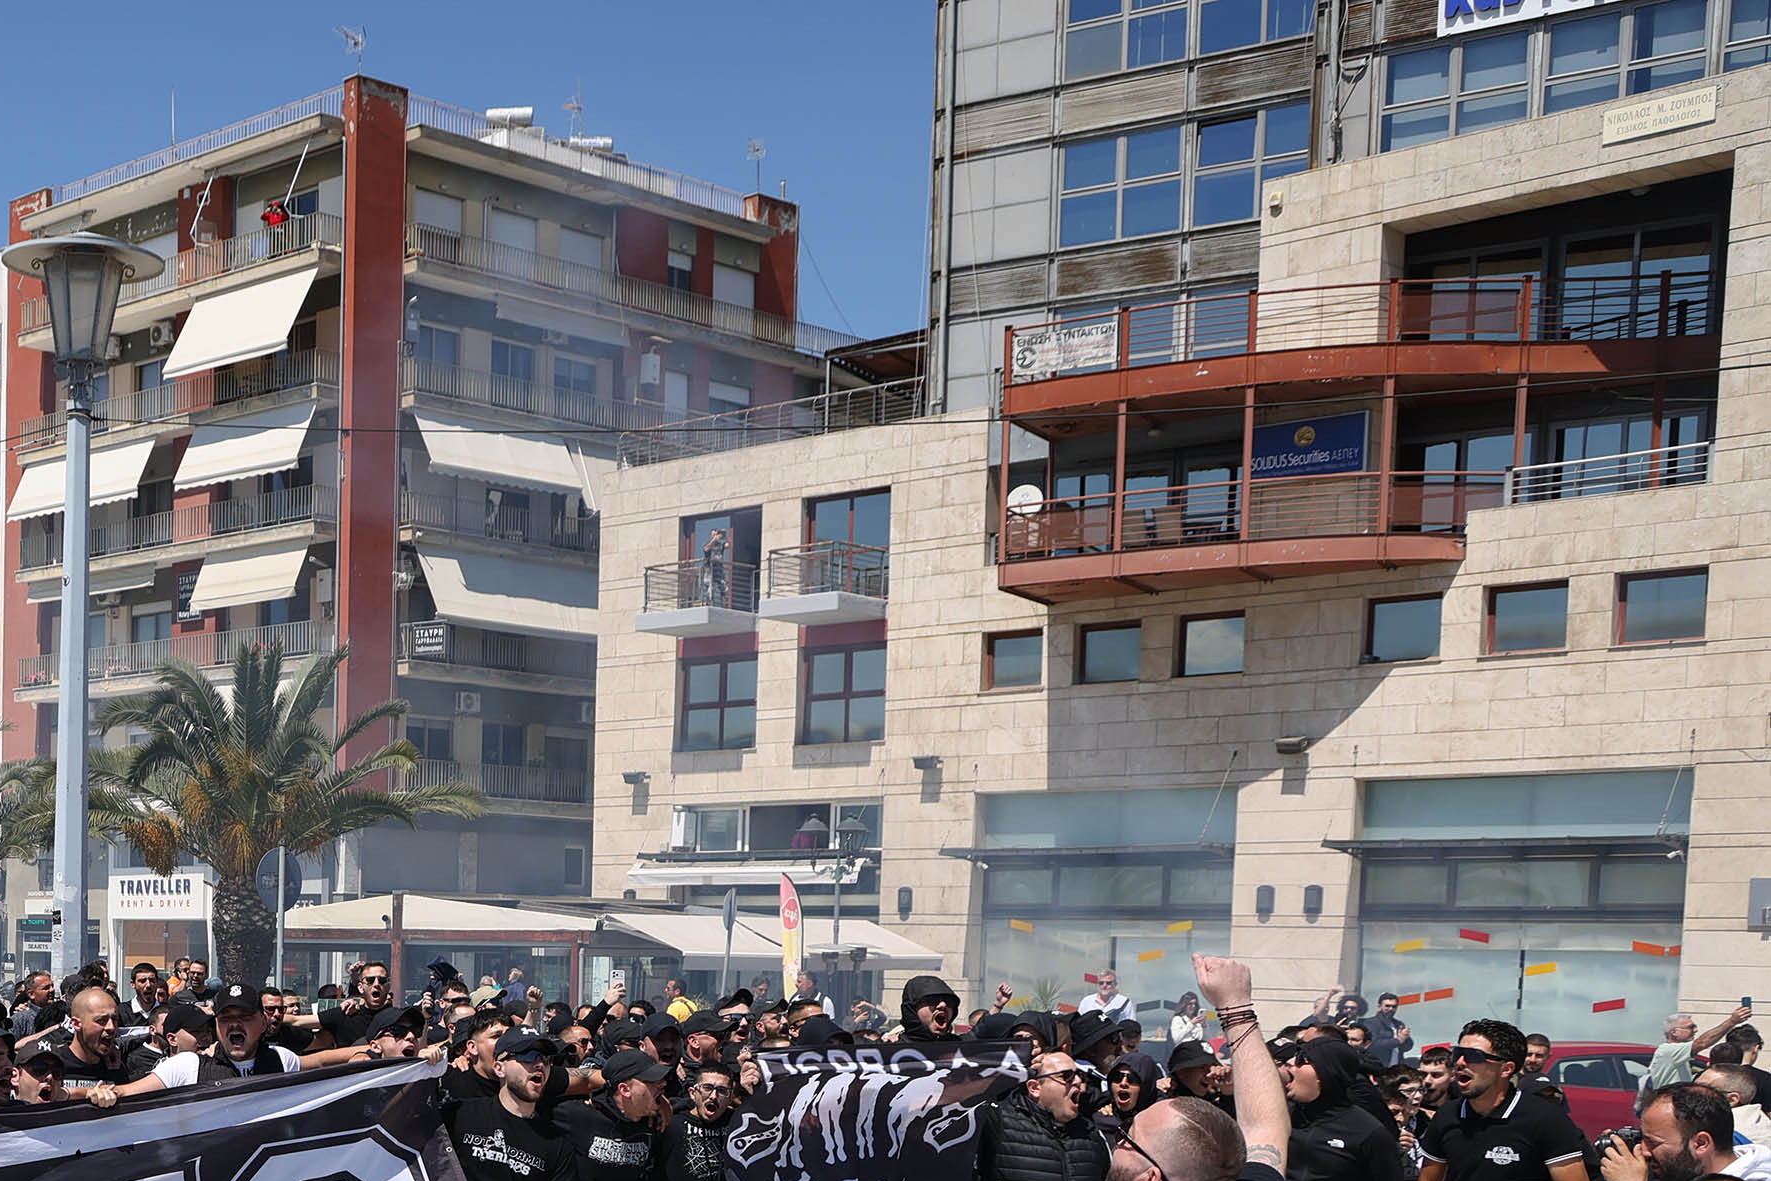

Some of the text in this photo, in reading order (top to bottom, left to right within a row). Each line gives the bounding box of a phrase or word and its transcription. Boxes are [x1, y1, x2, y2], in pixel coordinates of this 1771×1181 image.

[1608, 107, 1651, 125] ΝΙΚΟΛΑΟΣ
[1670, 92, 1713, 111] ΖΟΥΜΠΟΣ
[1616, 109, 1701, 136] ΕΙΔΙΚΟΣ ΠΑΘΟΛΟΓΟΣ
[1016, 334, 1051, 347] ΕΝΩΣΗ
[1288, 449, 1330, 466] Securities
[415, 628, 444, 638] ΣΤΑΥΡΗ
[120, 879, 191, 896] TRAVELLER
[121, 899, 143, 908] RENT
[160, 899, 190, 908] DRIVE
[463, 1133, 488, 1147] NOT
